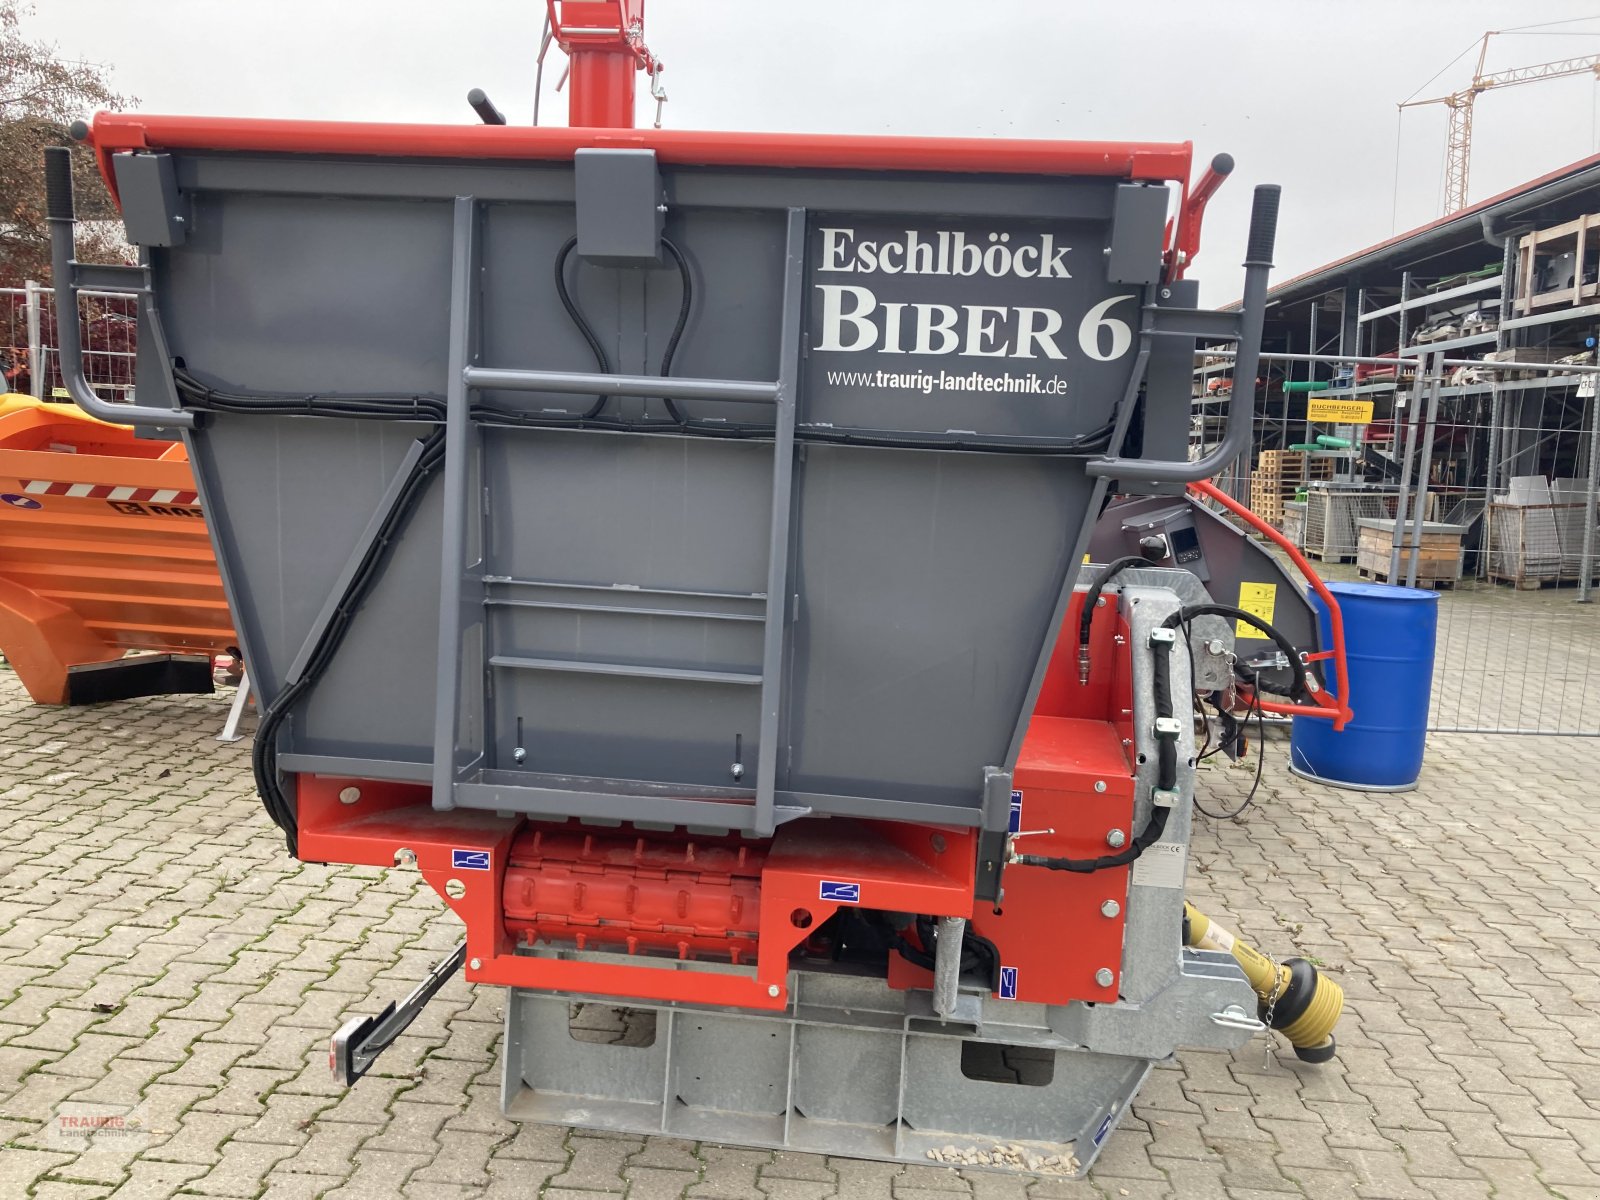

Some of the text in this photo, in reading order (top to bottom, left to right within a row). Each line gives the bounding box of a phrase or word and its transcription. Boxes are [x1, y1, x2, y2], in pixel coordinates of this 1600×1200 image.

[817, 227, 1073, 279] Eschlböck
[812, 284, 1136, 362] BIBER 6
[827, 368, 1068, 395] www.traurig-landtechnik.de
